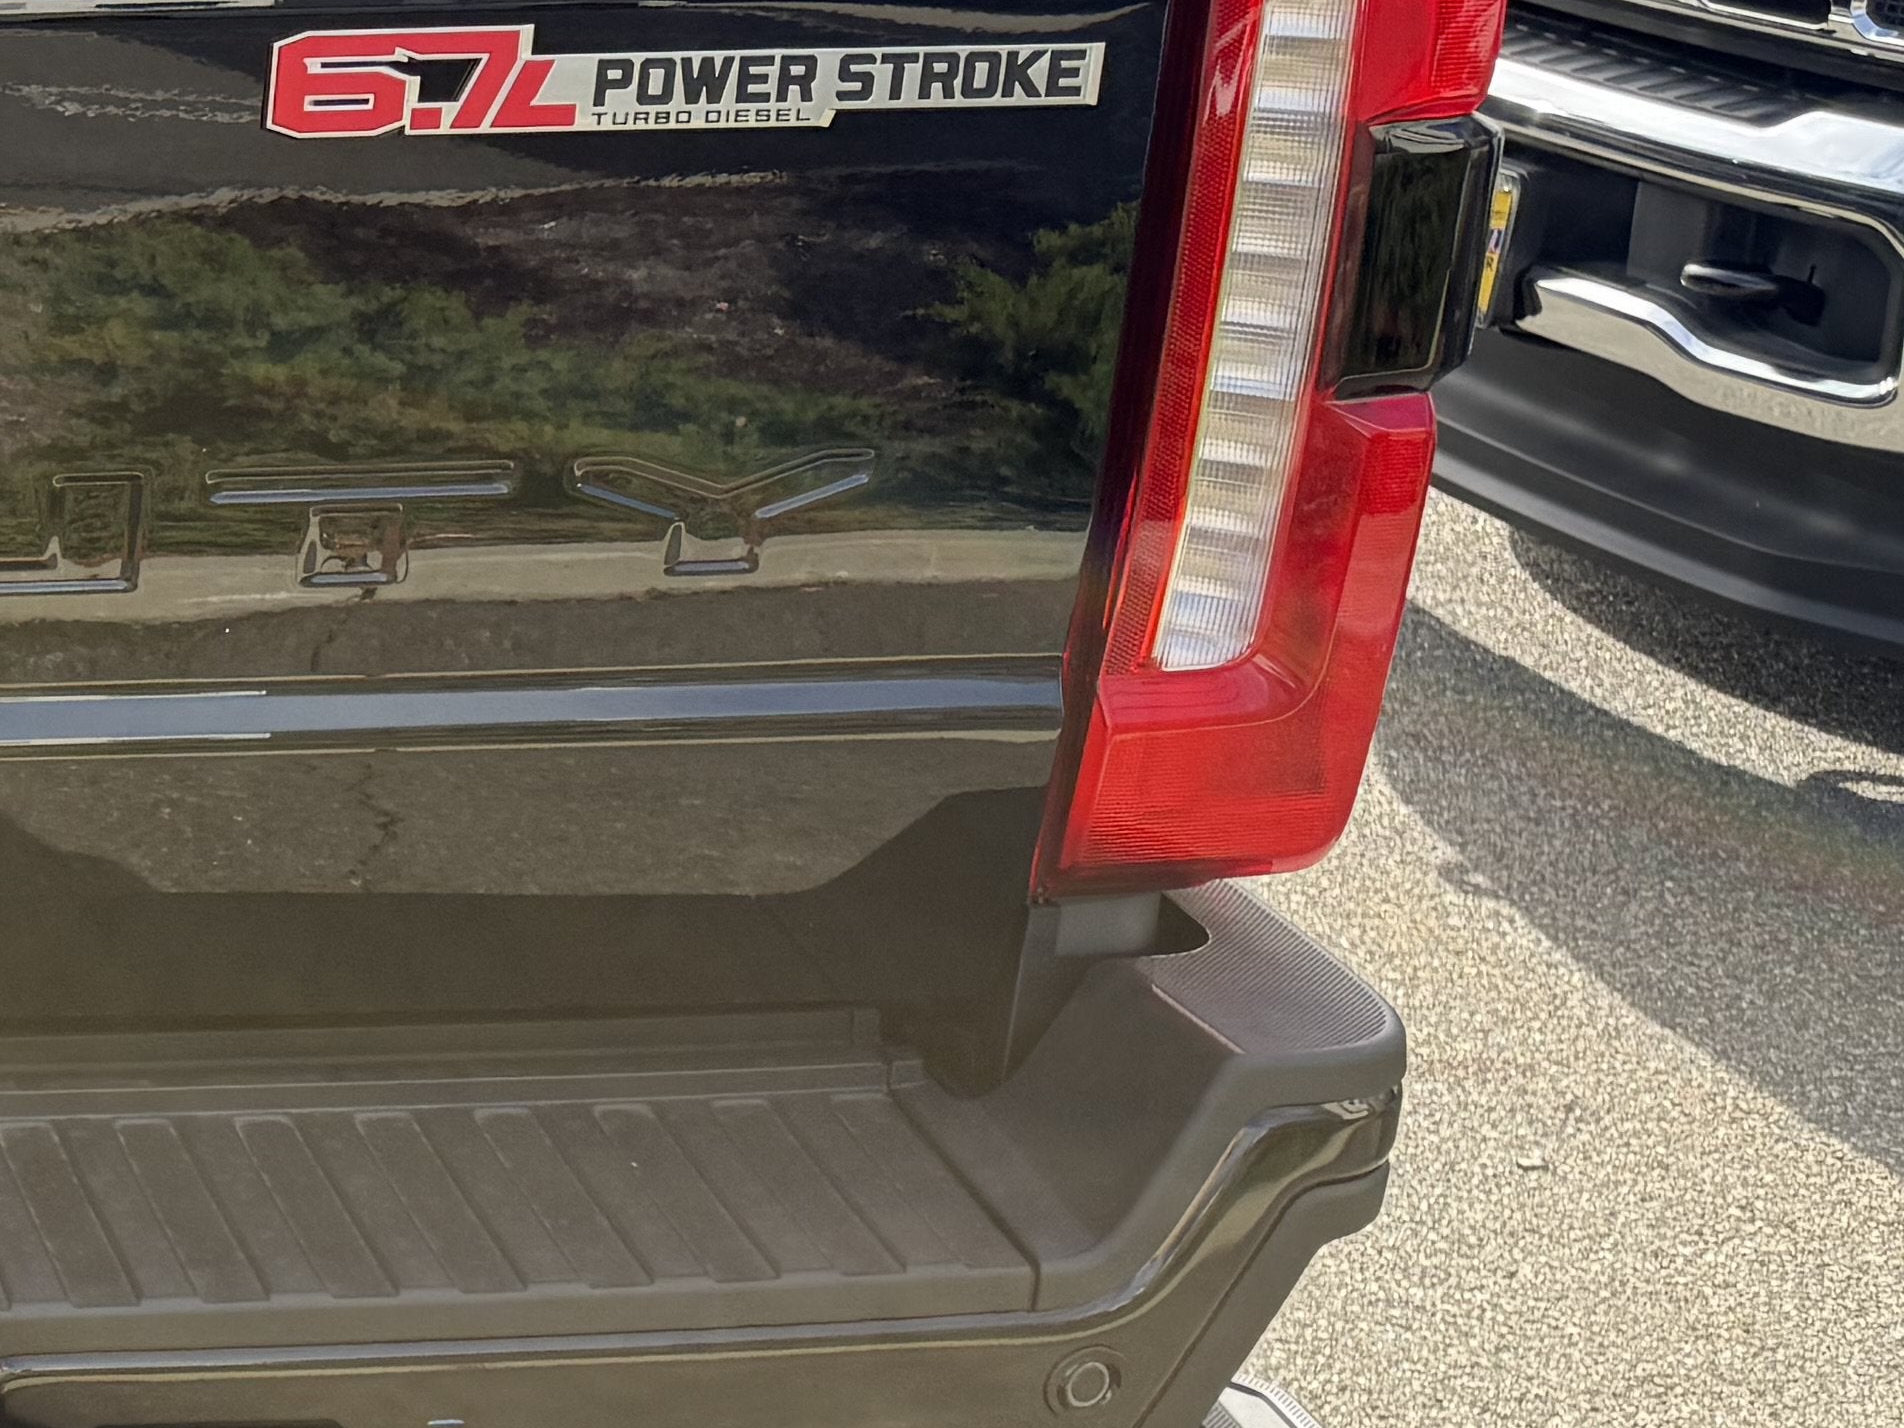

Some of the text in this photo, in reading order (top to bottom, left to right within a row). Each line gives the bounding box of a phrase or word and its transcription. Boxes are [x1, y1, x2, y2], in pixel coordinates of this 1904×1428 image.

[271, 30, 1088, 134] 6.7L POWER STROKE
[592, 107, 812, 126] TURBO DIESEL
